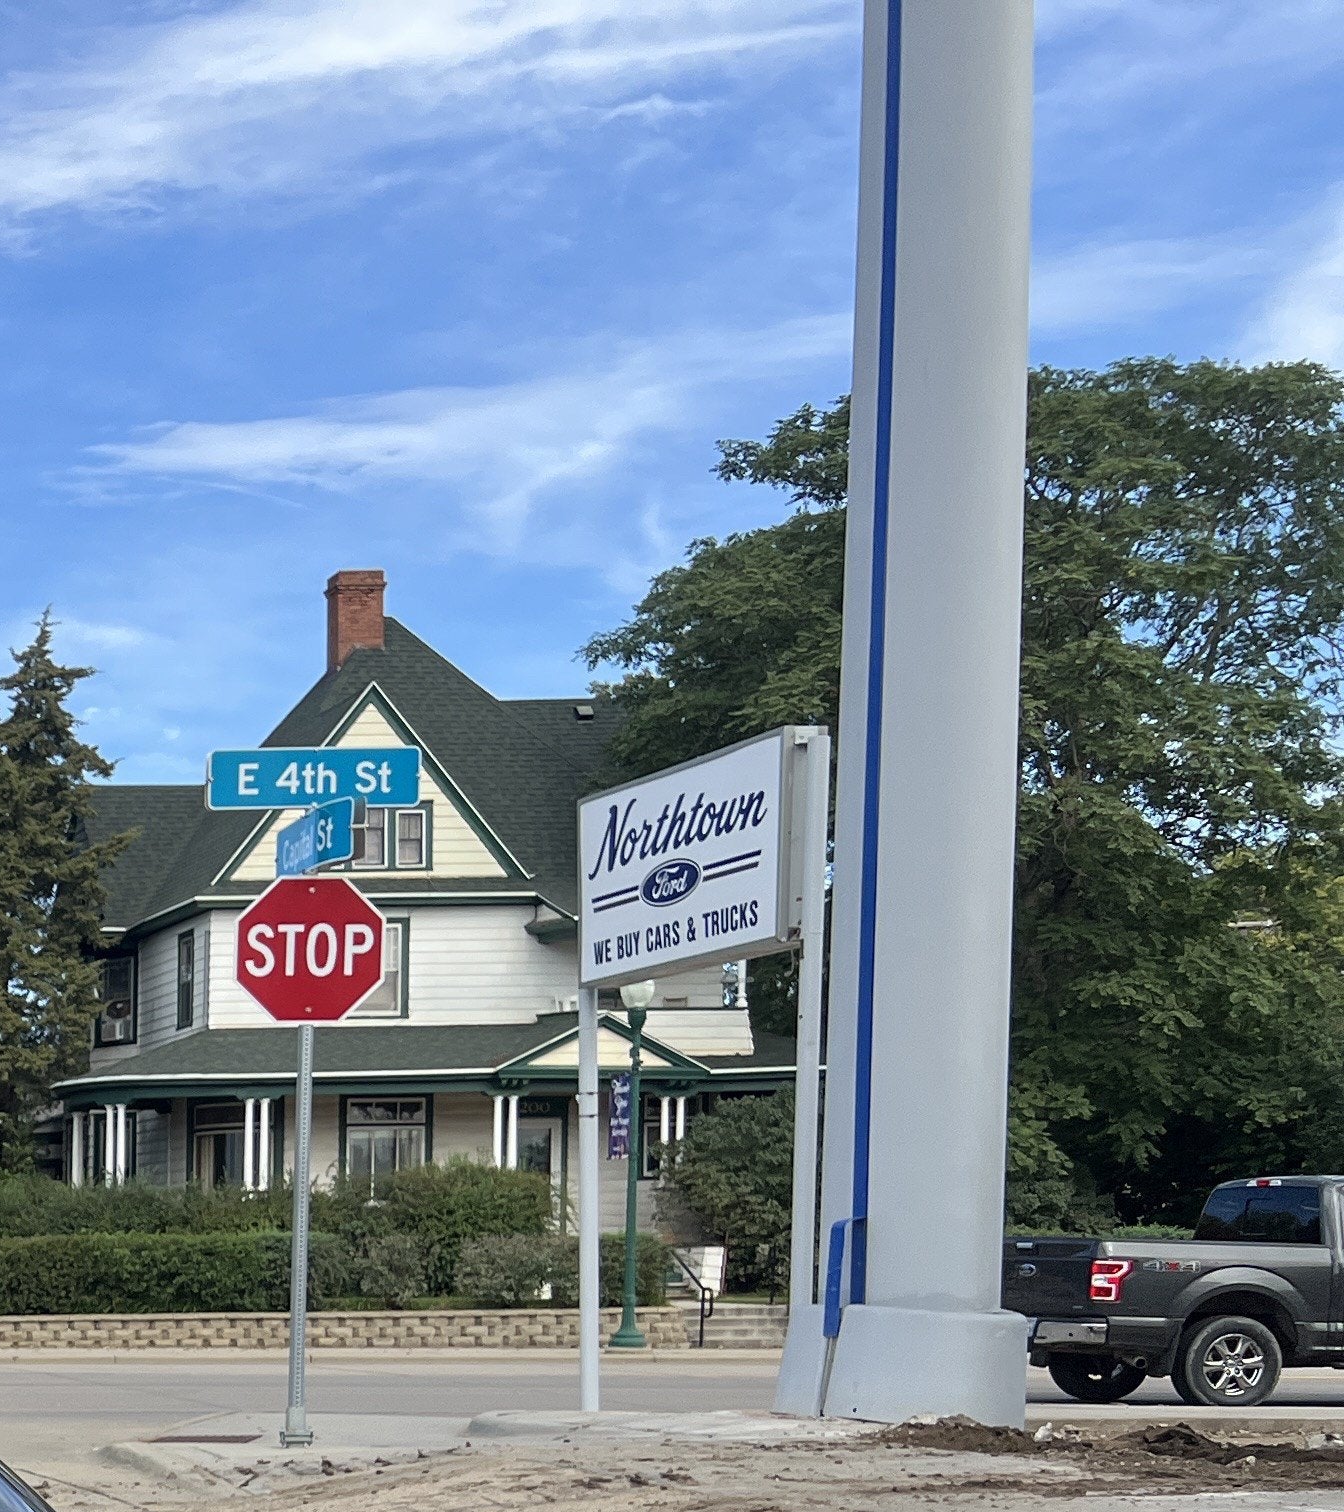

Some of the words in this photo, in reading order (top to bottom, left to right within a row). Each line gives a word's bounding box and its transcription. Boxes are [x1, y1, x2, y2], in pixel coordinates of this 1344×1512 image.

[237, 762, 260, 796] E
[275, 761, 338, 795] 4th
[354, 760, 392, 794] St
[316, 816, 334, 852] St
[588, 790, 768, 881] Northtown
[652, 865, 688, 900] Ford
[244, 922, 375, 979] STOP
[593, 938, 612, 965] WE
[617, 930, 640, 961] BUY
[646, 920, 680, 953] CARS
[686, 916, 696, 943] &
[702, 900, 759, 938] TRUCKS
